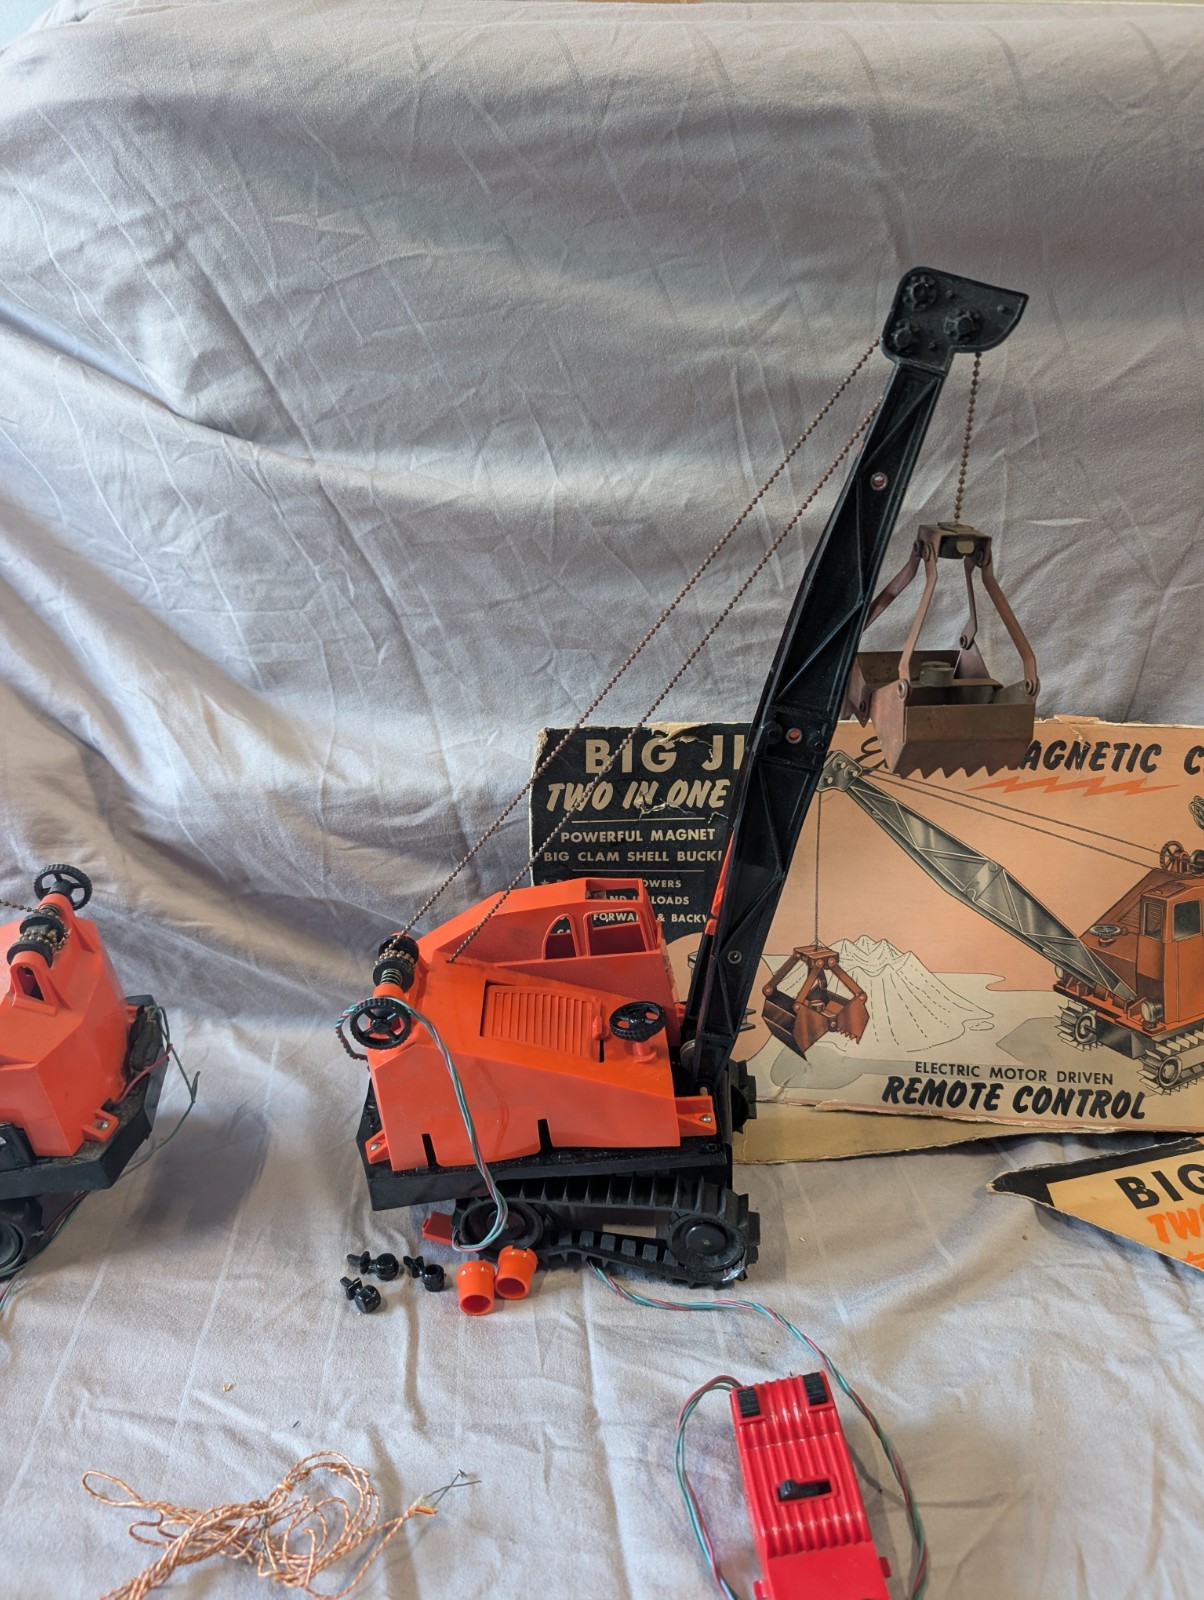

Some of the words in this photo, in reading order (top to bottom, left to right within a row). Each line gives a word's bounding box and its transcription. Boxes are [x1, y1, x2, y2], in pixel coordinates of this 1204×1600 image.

[585, 737, 677, 774] BIG
[702, 735, 745, 770] JI
[1019, 739, 1162, 774] AGNETIC
[1184, 745, 1204, 776] C
[546, 780, 614, 812] TWO
[622, 780, 660, 810] IN
[666, 779, 731, 809] ONE
[560, 830, 644, 843] POWERFUL
[650, 828, 716, 841] MAGNET
[543, 851, 570, 862] BIG
[577, 851, 620, 862] CLAM
[627, 850, 670, 862] SHELL
[676, 850, 723, 862] BUCK
[643, 879, 682, 888] OWERS
[593, 912, 638, 922] FORWA
[671, 913, 707, 923] BACK
[915, 1061, 980, 1078] ELECTRIC
[989, 1067, 1047, 1082] MOTOR
[1056, 1070, 1114, 1086] DRIVEN
[881, 1075, 1004, 1112] REMOTE
[1012, 1085, 1146, 1120] CONTROL
[1114, 1163, 1204, 1210] BIG
[1146, 1203, 1204, 1244] TW
